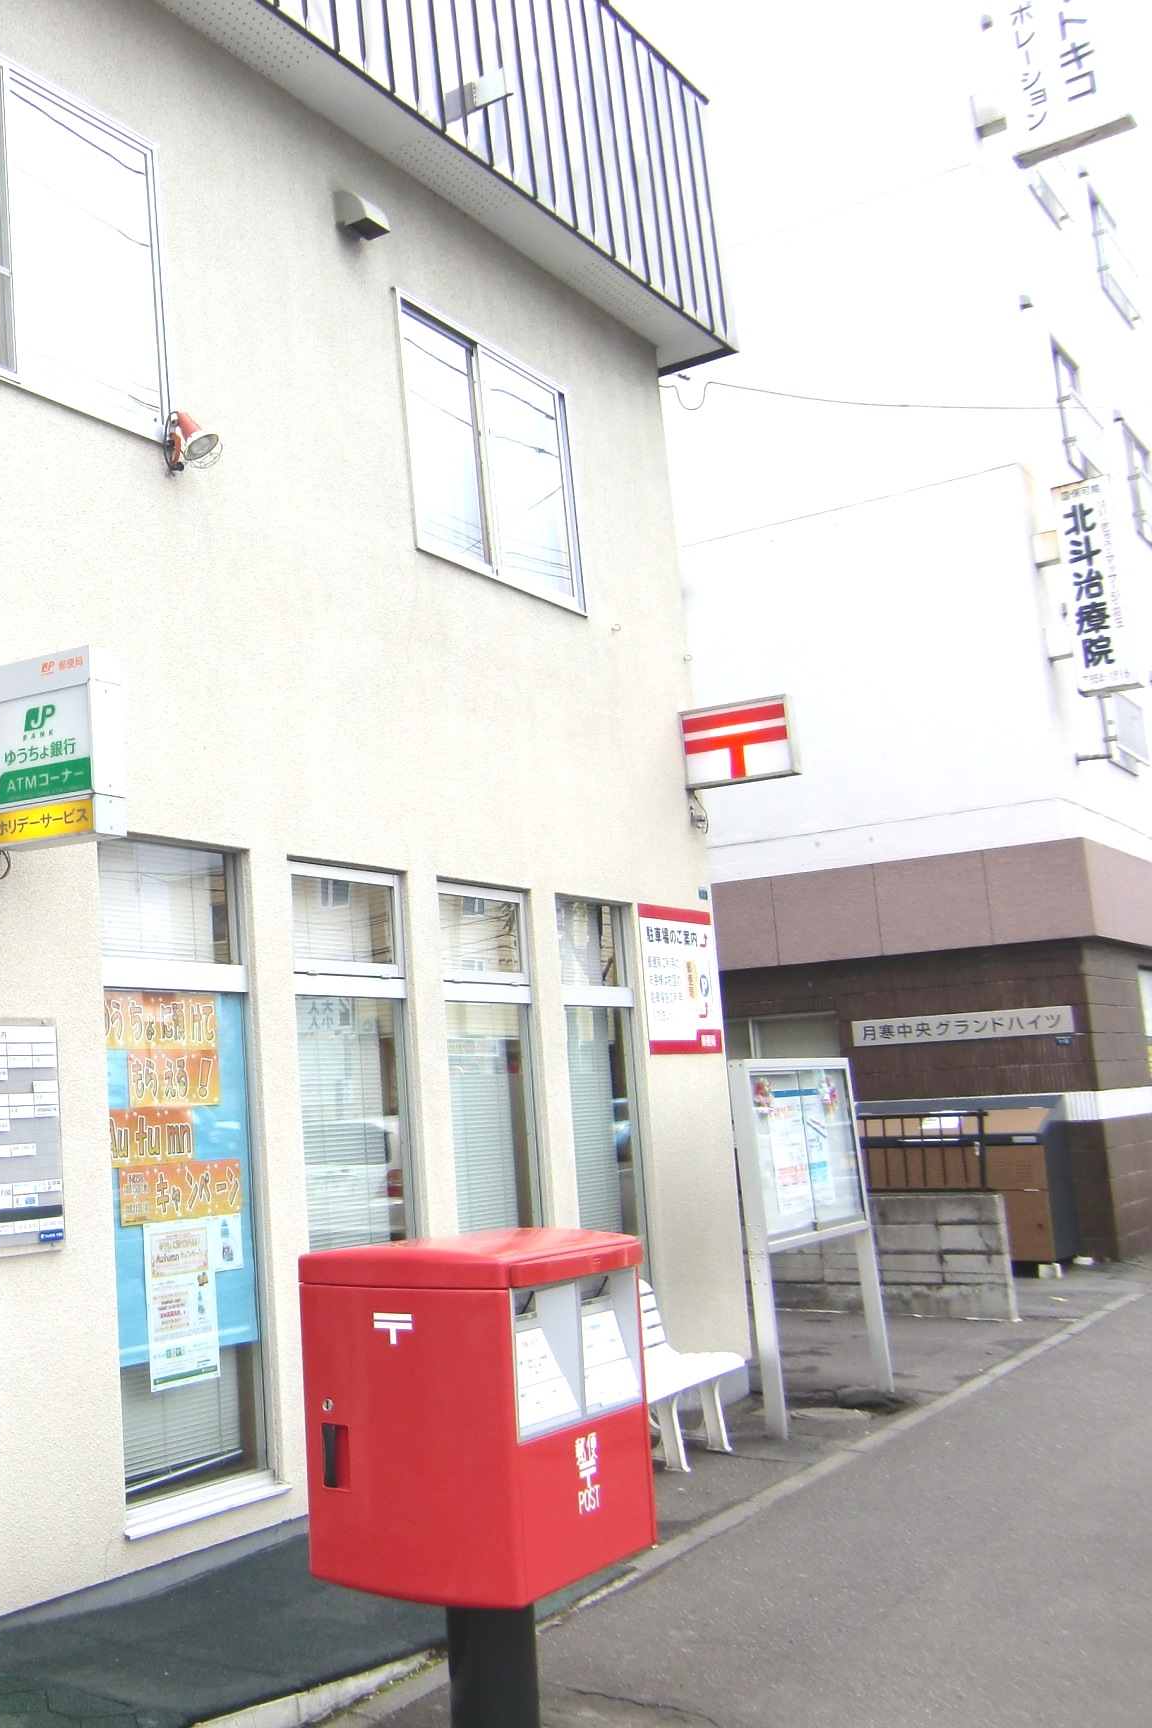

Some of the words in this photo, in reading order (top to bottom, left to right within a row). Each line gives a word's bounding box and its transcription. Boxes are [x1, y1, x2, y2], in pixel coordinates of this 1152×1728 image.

[1058, 0, 1097, 102] トキコ
[1063, 503, 1116, 669] 北斗治療院
[24, 704, 56, 731] JP
[23, 729, 54, 741] BANK
[5, 737, 77, 766] ゆうちょ銀行
[6, 767, 85, 793] ATMコーナー
[646, 926, 699, 947] 駐車場のご案内
[861, 1013, 1062, 1042] 月寒中央グランドハイツ
[109, 1115, 193, 1159] Autumn
[155, 1168, 240, 1214] キャンペーン
[577, 1484, 601, 1515] POST
